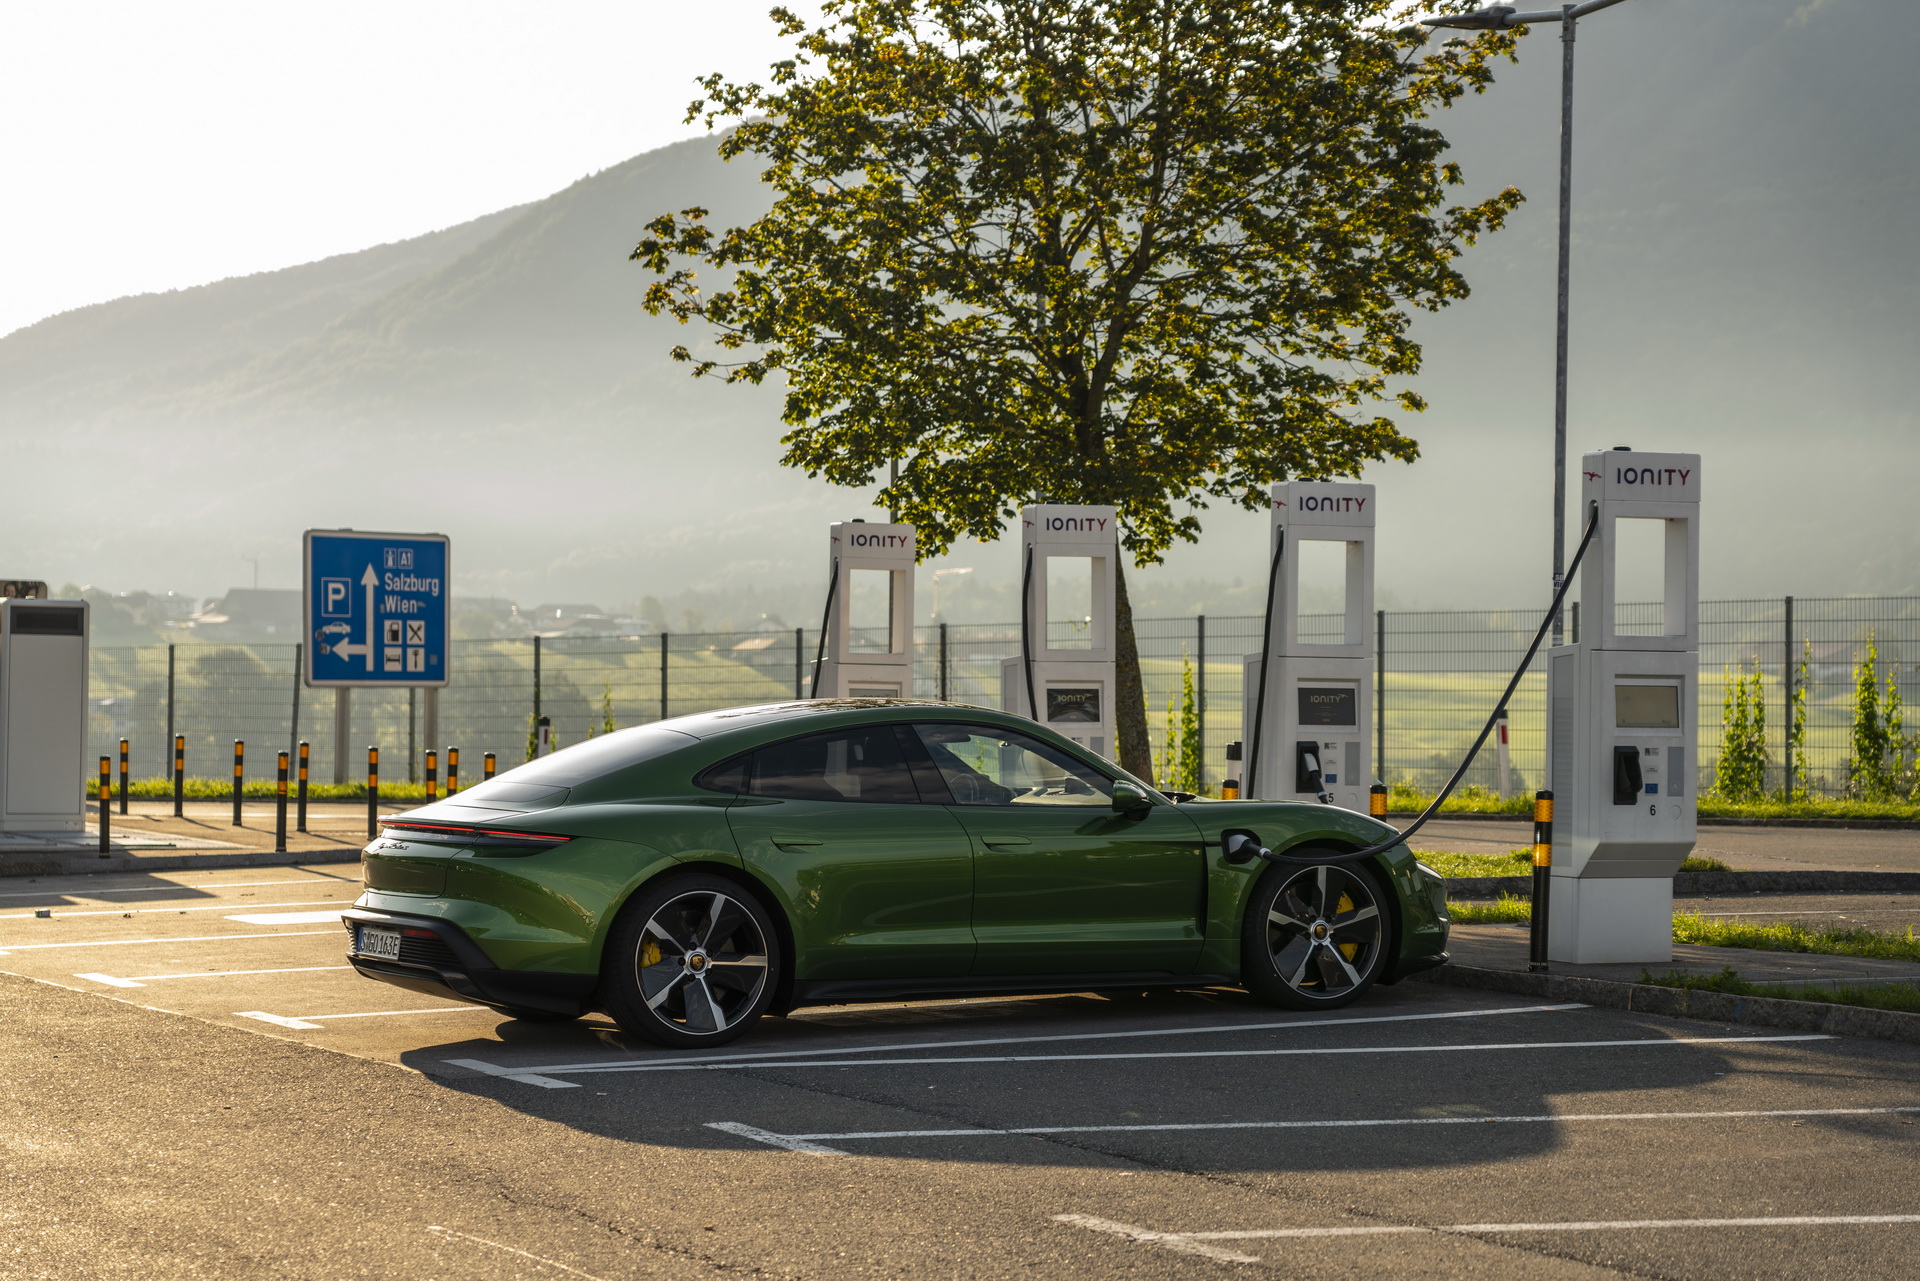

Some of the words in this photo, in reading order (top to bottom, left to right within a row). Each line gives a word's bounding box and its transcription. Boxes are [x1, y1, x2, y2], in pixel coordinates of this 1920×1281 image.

[1617, 467, 1691, 486] IONITY
[1299, 496, 1367, 512] IONITY
[1046, 517, 1108, 532] IONITY
[851, 534, 908, 548] IONITY
[400, 552, 412, 566] A1
[384, 572, 440, 597] Salzburg
[327, 582, 346, 613] P
[384, 595, 418, 614] Wien
[1328, 792, 1334, 803] 5
[1649, 804, 1656, 816] 6
